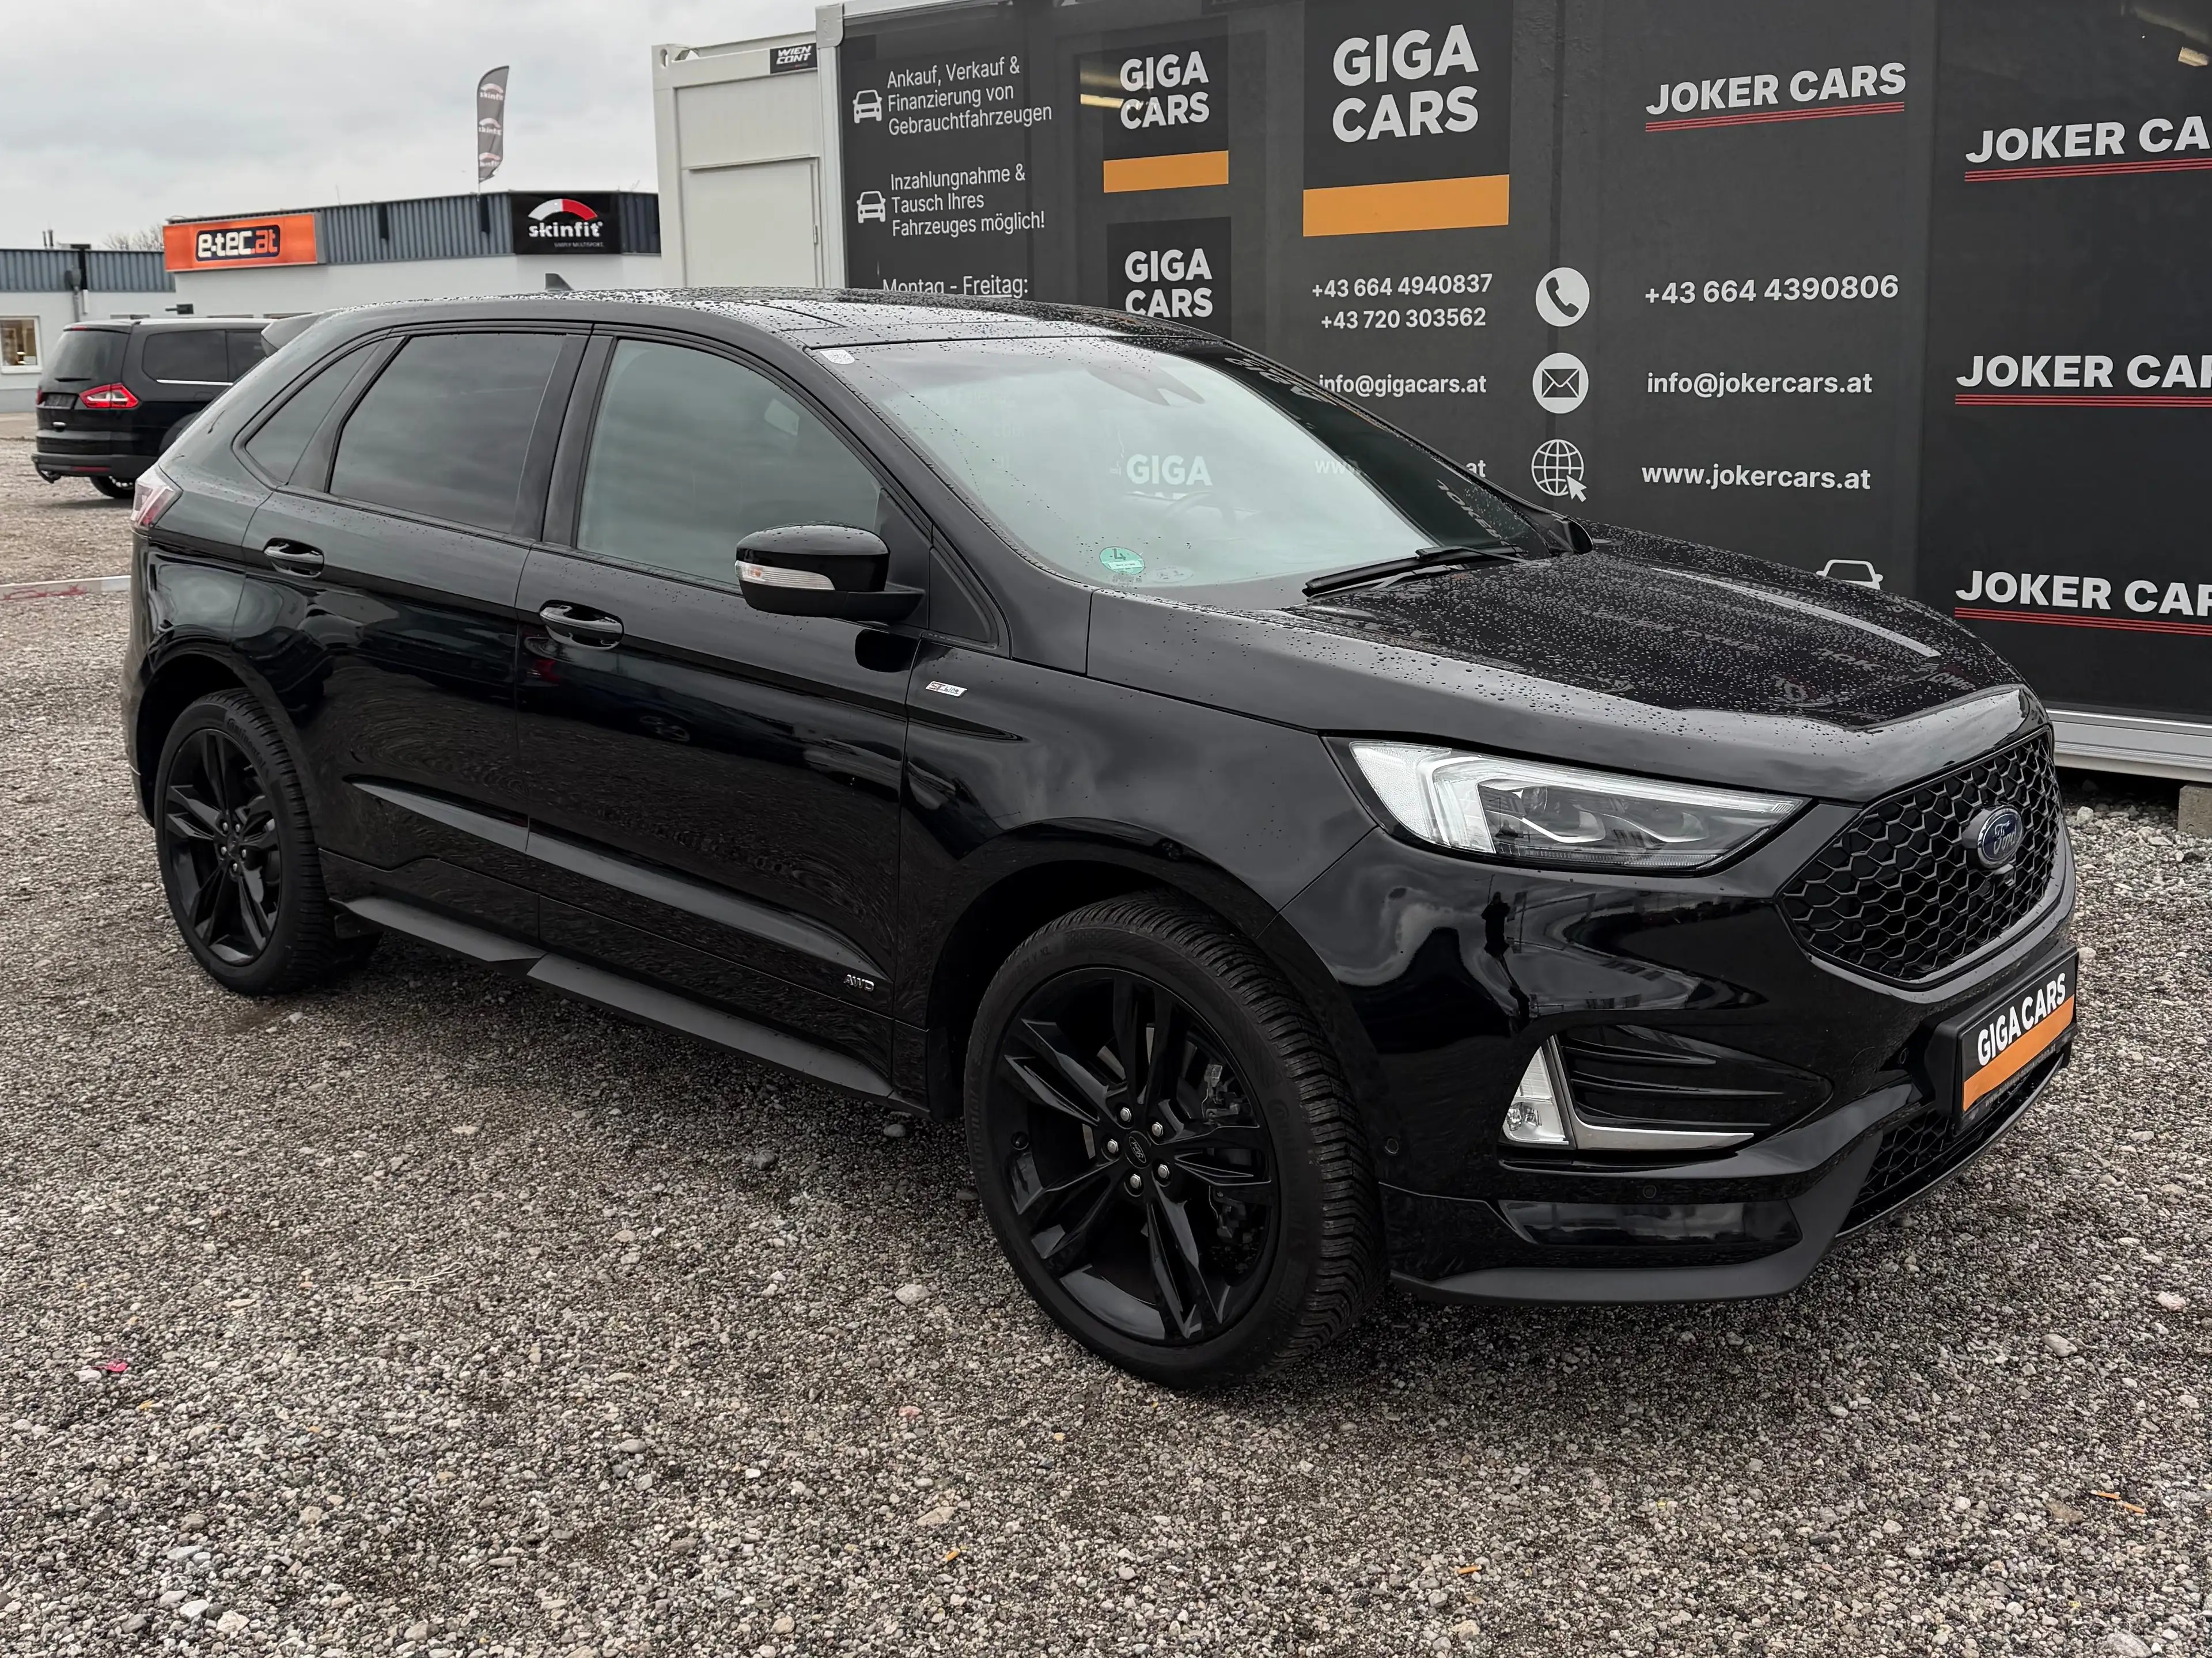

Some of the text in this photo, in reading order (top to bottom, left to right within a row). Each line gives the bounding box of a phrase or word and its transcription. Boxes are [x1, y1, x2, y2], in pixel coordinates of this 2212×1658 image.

[776, 53, 811, 65] CONT
[778, 45, 812, 57] WIEN
[1333, 24, 1479, 86] GIGA
[887, 56, 1020, 89] Ankauf, Verkauf &
[1120, 51, 1209, 92] GIGA
[888, 85, 1014, 112] Finanzierung von
[1646, 62, 1906, 115] JOKER CARS
[889, 105, 1052, 135] Gebrauchtfahrzeugen
[1120, 91, 1210, 130] CARS
[1332, 86, 1479, 143] CARS
[1965, 122, 2126, 164] JOKER
[891, 163, 1025, 190] Inzahlungnahme &
[891, 192, 984, 214] Tausch Ihres
[892, 210, 1044, 238] Fahrzeuges möglich!
[1124, 248, 1213, 283] GIGA
[963, 274, 1028, 298] Freitag:
[1312, 273, 1493, 298] +43 664 4940837
[1645, 274, 1899, 304] +43 664 4390806
[1125, 287, 1213, 317] CARS
[1321, 307, 1486, 329] +43 720 303562
[1647, 371, 1873, 398] info@jokercars.at
[1956, 355, 2113, 387] JOKER
[1126, 454, 1213, 487] GIGA
[1642, 463, 1871, 490] www.jokercars.at
[1955, 570, 2111, 610] JOKER
[1993, 820, 2016, 855] Ford
[843, 974, 874, 992] AWD
[1978, 973, 2066, 1065] GIGA CARS
